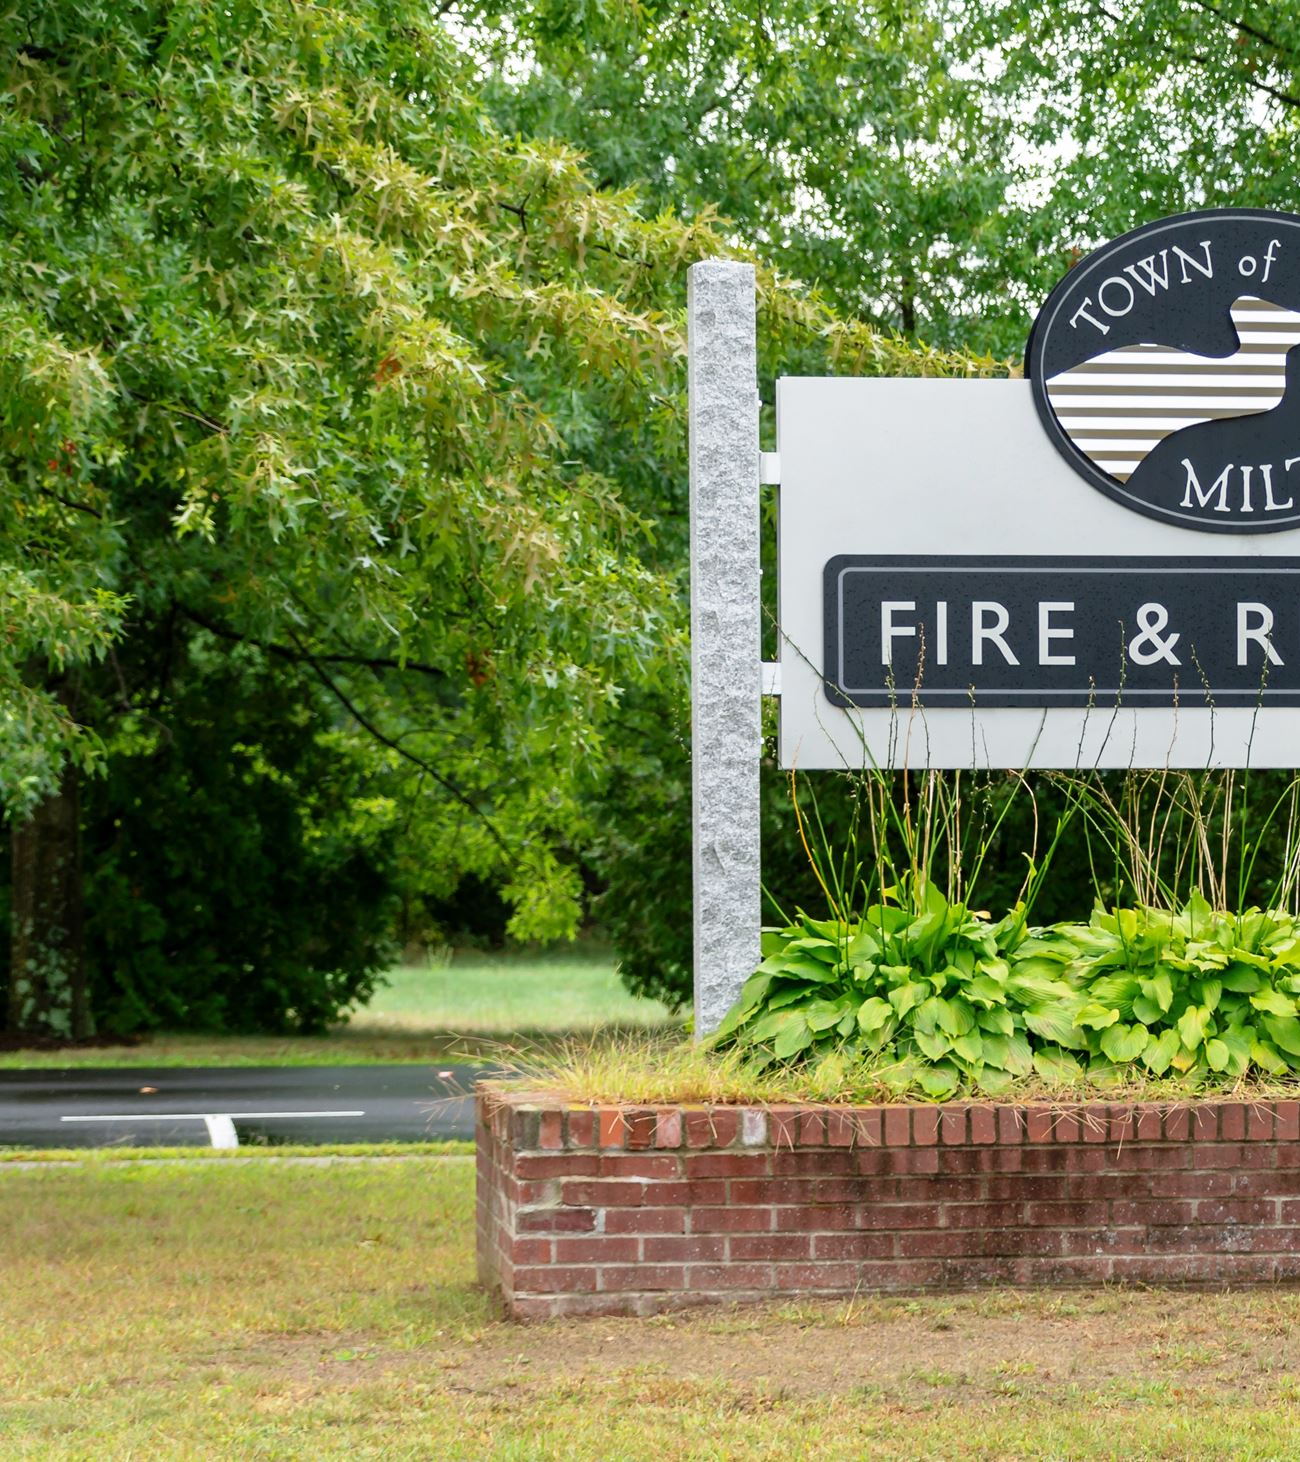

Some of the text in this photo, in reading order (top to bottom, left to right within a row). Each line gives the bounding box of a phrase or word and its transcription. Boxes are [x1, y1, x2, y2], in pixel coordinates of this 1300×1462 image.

[1069, 239, 1281, 335] TOWN of
[881, 601, 1076, 666] FIRE
[1128, 602, 1182, 666] &
